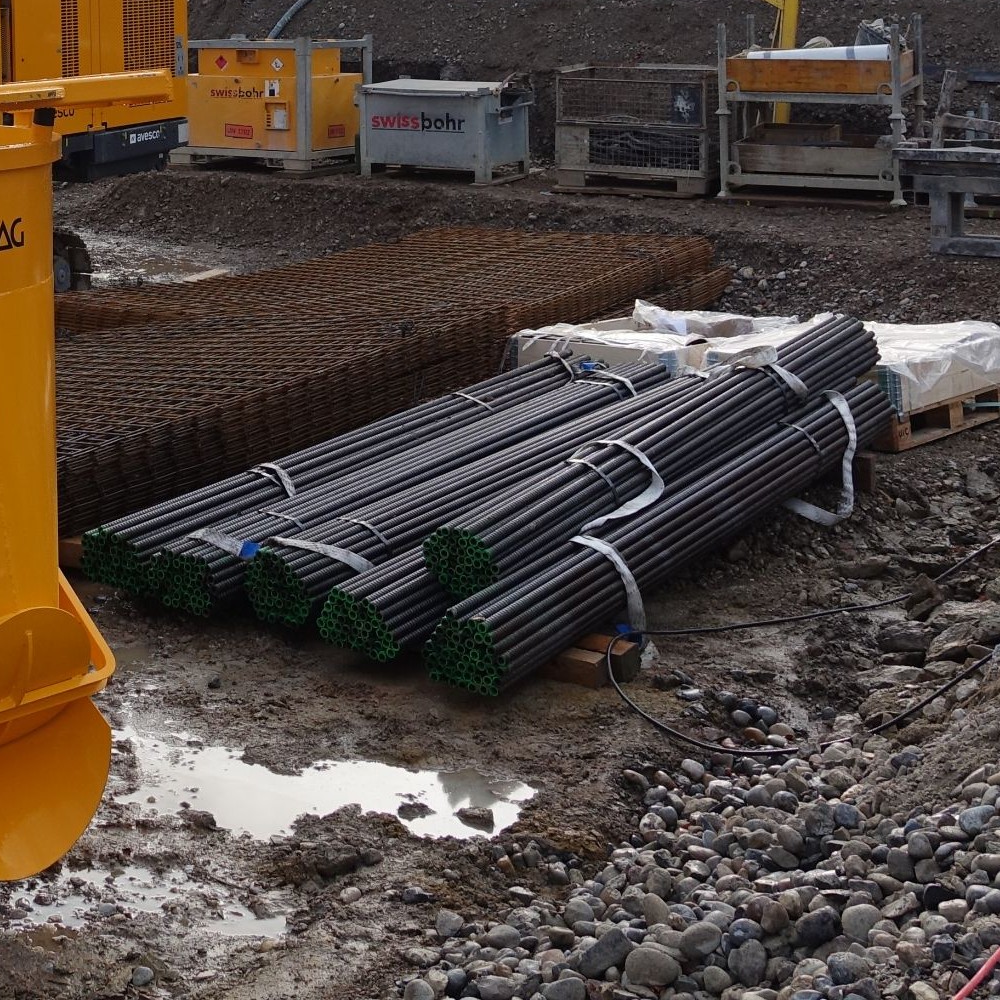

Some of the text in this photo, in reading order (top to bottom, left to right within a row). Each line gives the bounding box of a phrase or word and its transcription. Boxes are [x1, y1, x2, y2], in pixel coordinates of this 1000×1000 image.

[210, 87, 264, 99] swissbohr
[371, 112, 465, 133] swissbohr
[136, 130, 161, 143] avesco
